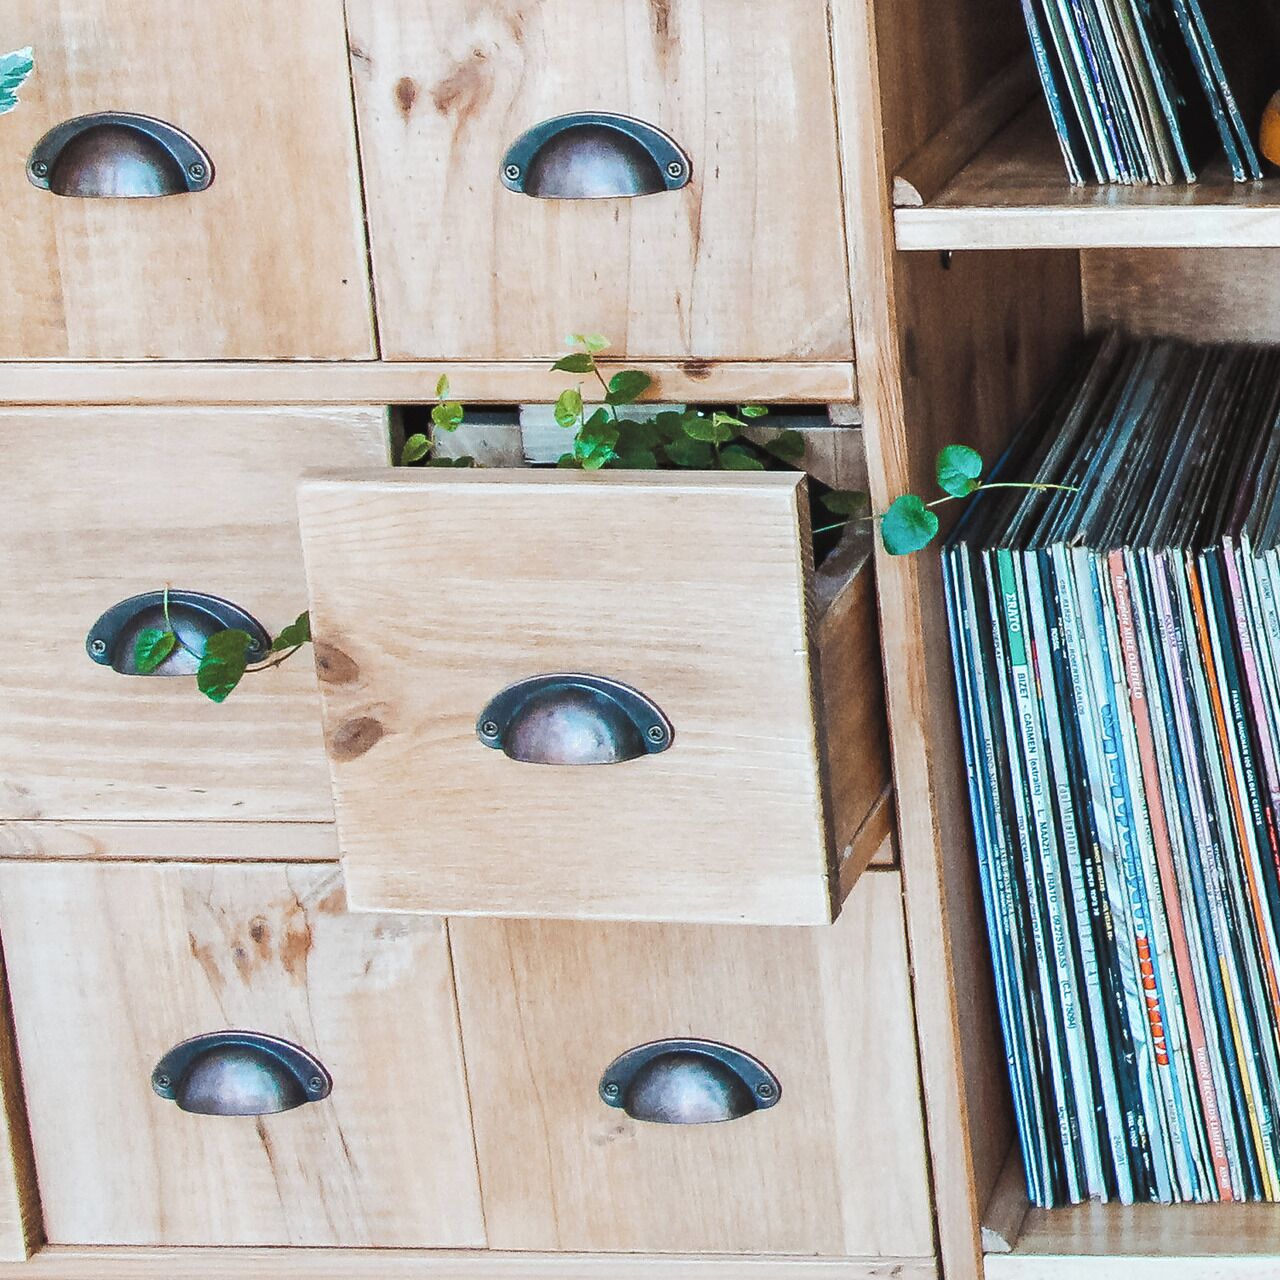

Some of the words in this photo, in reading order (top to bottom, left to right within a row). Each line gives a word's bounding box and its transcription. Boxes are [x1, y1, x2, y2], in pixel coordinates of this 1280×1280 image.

[1114, 576, 1125, 589] the
[1114, 590, 1131, 625] complete
[1122, 627, 1136, 653] MIKE
[1067, 648, 1080, 682] ROBERTO
[1126, 654, 1144, 698] OLDFIELD
[1016, 673, 1028, 699] BIZET
[1073, 684, 1085, 715] CARLOS
[1229, 690, 1243, 718] FRANKIE
[1022, 713, 1036, 753] CARMEN
[1235, 720, 1250, 754] VAUGHAN
[1027, 758, 1043, 795] (extraits)
[1244, 769, 1258, 797] GOLDEN
[1250, 798, 1263, 825] GREATS
[1037, 821, 1051, 859] MAAZEL
[1044, 872, 1057, 902] ERATO
[1195, 1047, 1209, 1078] VIRGIN
[1200, 1079, 1217, 1121] RECORDS
[1208, 1121, 1224, 1158] LIMITED
